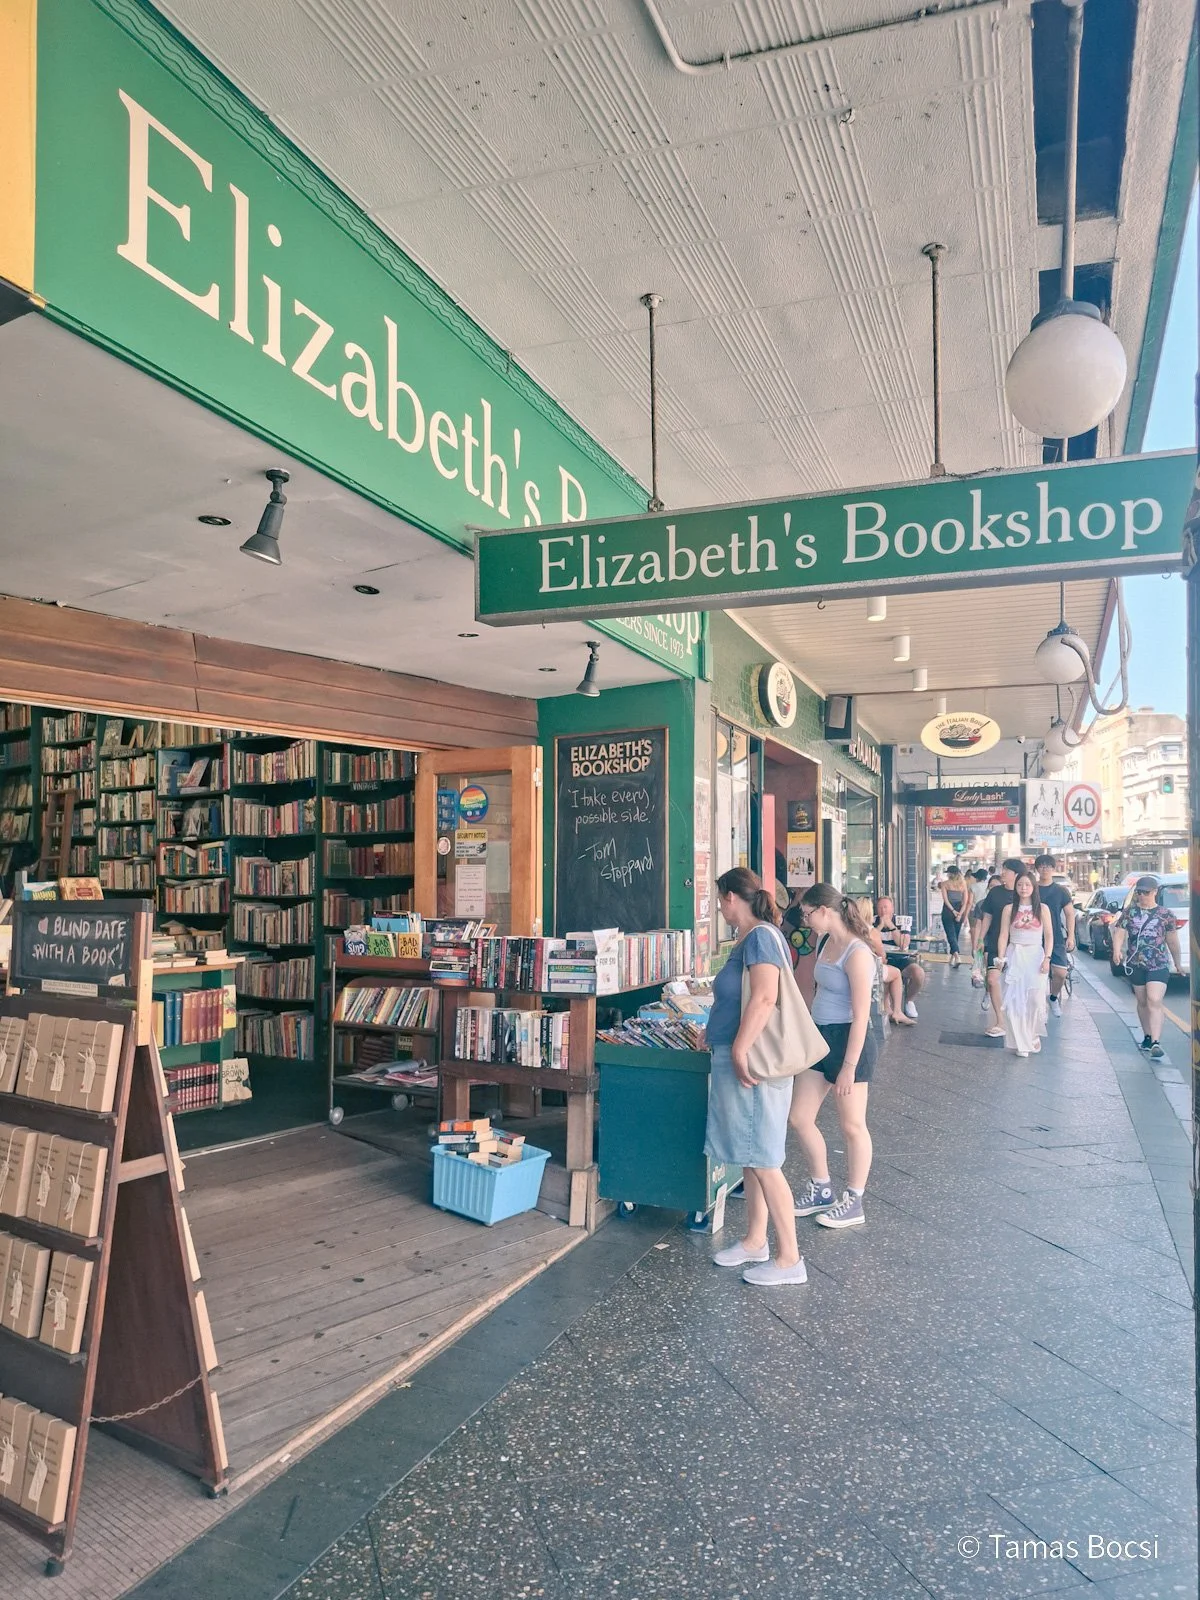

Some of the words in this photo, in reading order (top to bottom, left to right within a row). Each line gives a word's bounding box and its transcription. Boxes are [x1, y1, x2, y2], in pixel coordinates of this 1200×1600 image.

[117, 88, 539, 528] Elizabeth's
[538, 511, 816, 594] Elizabeth's
[842, 481, 1164, 565] Bookshop
[643, 620, 668, 650] SINCE
[670, 637, 685, 659] 1973
[946, 717, 969, 725] ITALIAN
[570, 739, 653, 762] ELIZABETH'S
[572, 756, 651, 777] BOOKSHOP
[581, 786, 607, 807] take
[1071, 796, 1096, 817] 40
[575, 807, 619, 834] possible
[1066, 831, 1101, 844] AREA
[600, 837, 655, 888] Stoppard
[53, 916, 91, 939] BLIND
[94, 919, 127, 940] DATE
[400, 946, 418, 956] GUYS
[402, 936, 418, 947] BAD
[66, 944, 75, 964] A
[222, 1069, 245, 1078] BROWN
